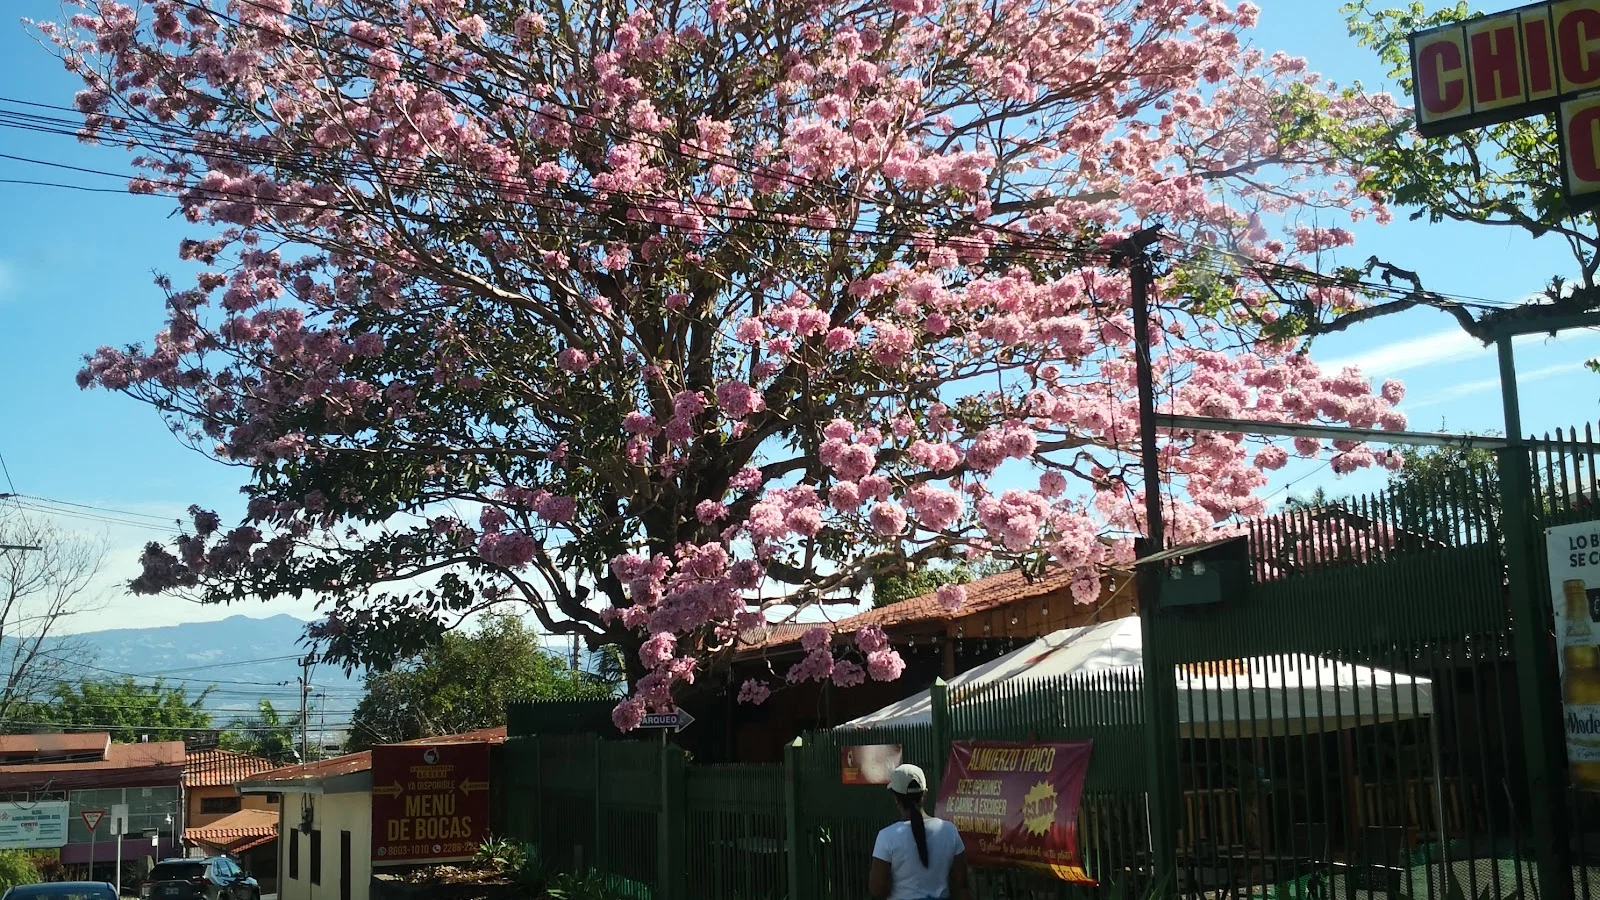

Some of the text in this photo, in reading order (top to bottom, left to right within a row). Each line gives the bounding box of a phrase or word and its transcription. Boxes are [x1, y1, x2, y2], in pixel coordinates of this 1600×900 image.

[1569, 536, 1587, 550] LO
[1569, 553, 1586, 567] SE
[642, 716, 678, 725] ARQUEO
[967, 745, 1056, 773] ALMUERZO TÍPICO
[408, 780, 456, 790] YA DISPONIBLE
[405, 790, 456, 817] MENÚ
[387, 816, 472, 841] DE BOCAS
[388, 844, 430, 856] 8603-1010
